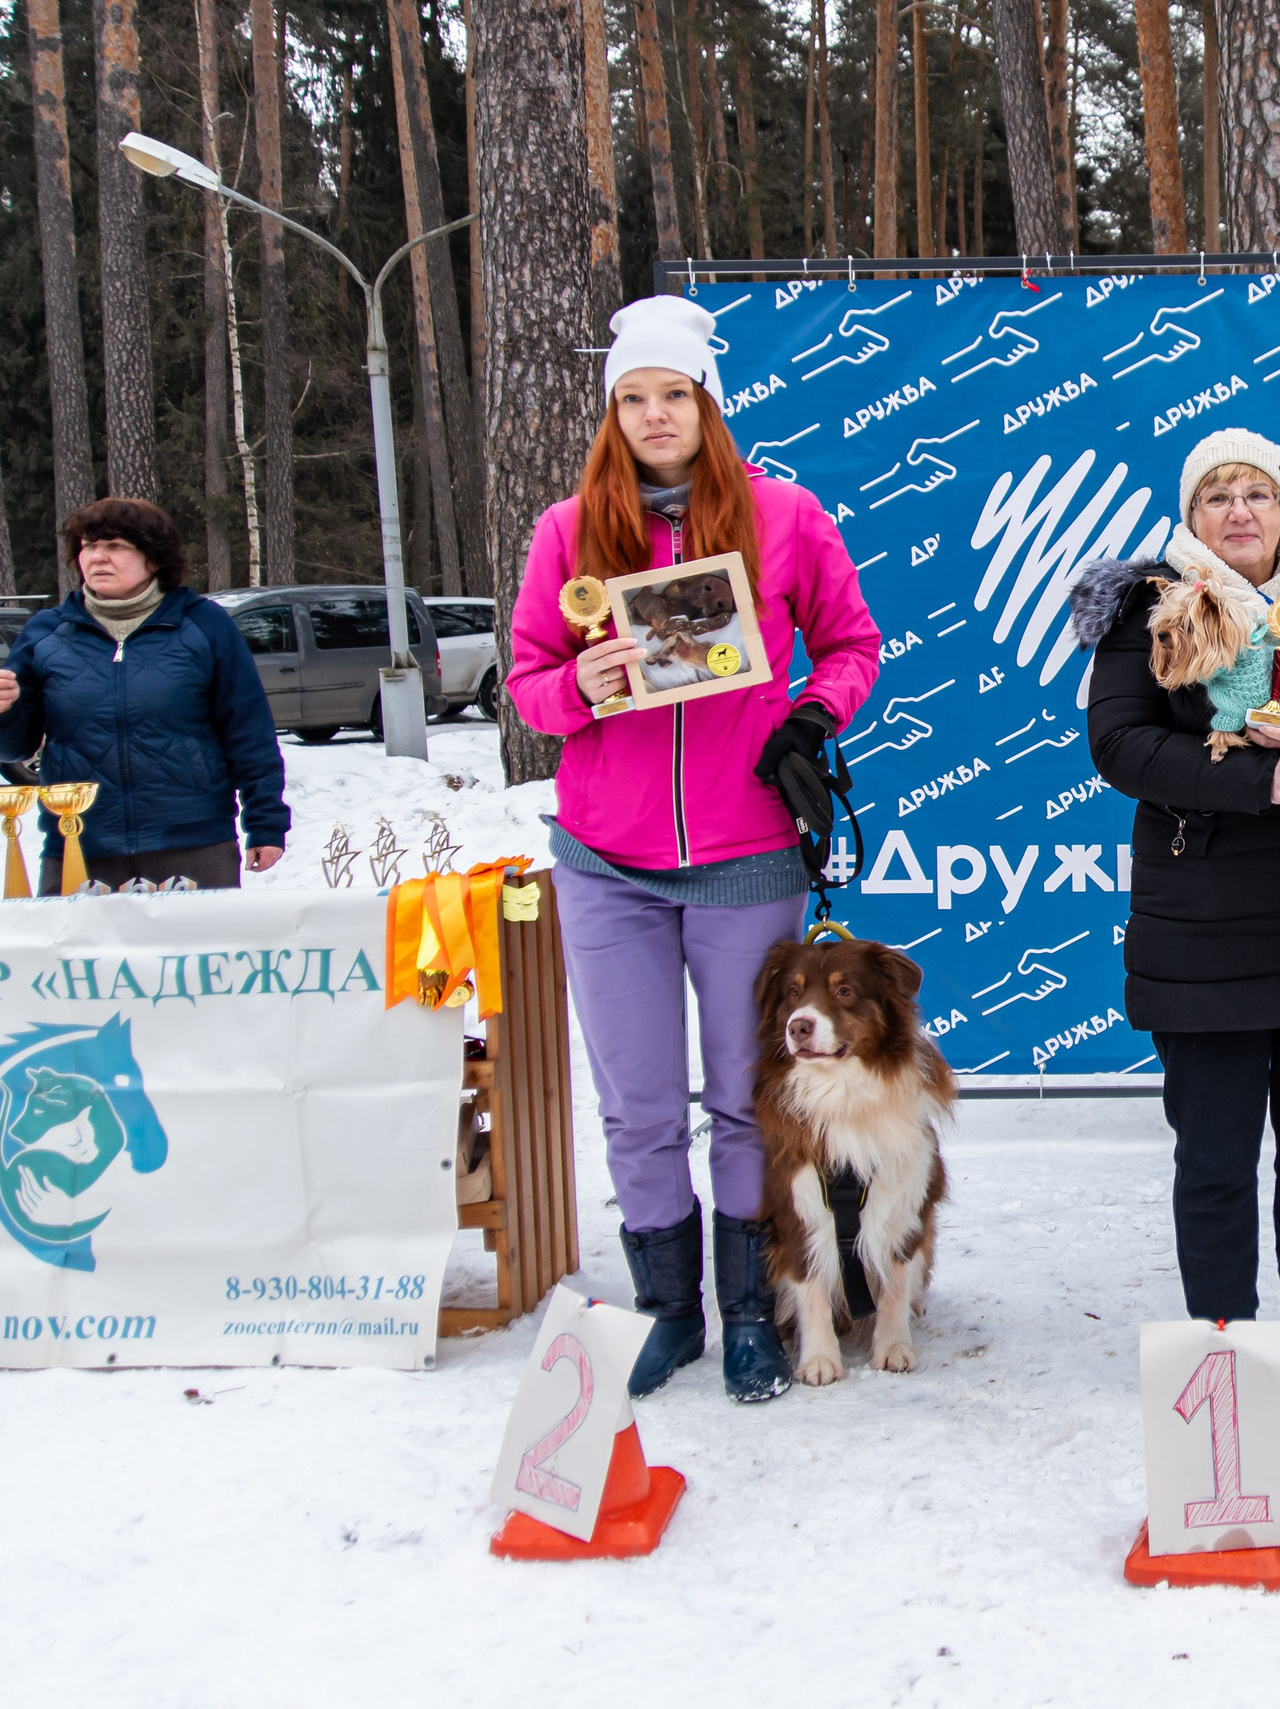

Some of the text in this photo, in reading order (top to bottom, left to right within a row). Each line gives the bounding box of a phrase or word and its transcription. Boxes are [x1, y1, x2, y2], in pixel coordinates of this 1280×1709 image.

[722, 373, 787, 418] УЖБА
[842, 376, 936, 438] ДРУЖБА
[1003, 372, 1098, 435] ДРУЖБА
[1153, 374, 1249, 437] ДРУЖБА
[898, 757, 991, 817] ДРУЖБА
[1046, 773, 1112, 820] ДРУЖ
[1032, 1007, 1125, 1066] ДРУЖБА
[225, 1275, 426, 1300] 8-930-804-31-88
[2, 1314, 157, 1340] nov.com
[222, 1316, 419, 1339] zoocenternn@mail.ru
[515, 1333, 593, 1512] 2
[1173, 1350, 1273, 1529] 1
